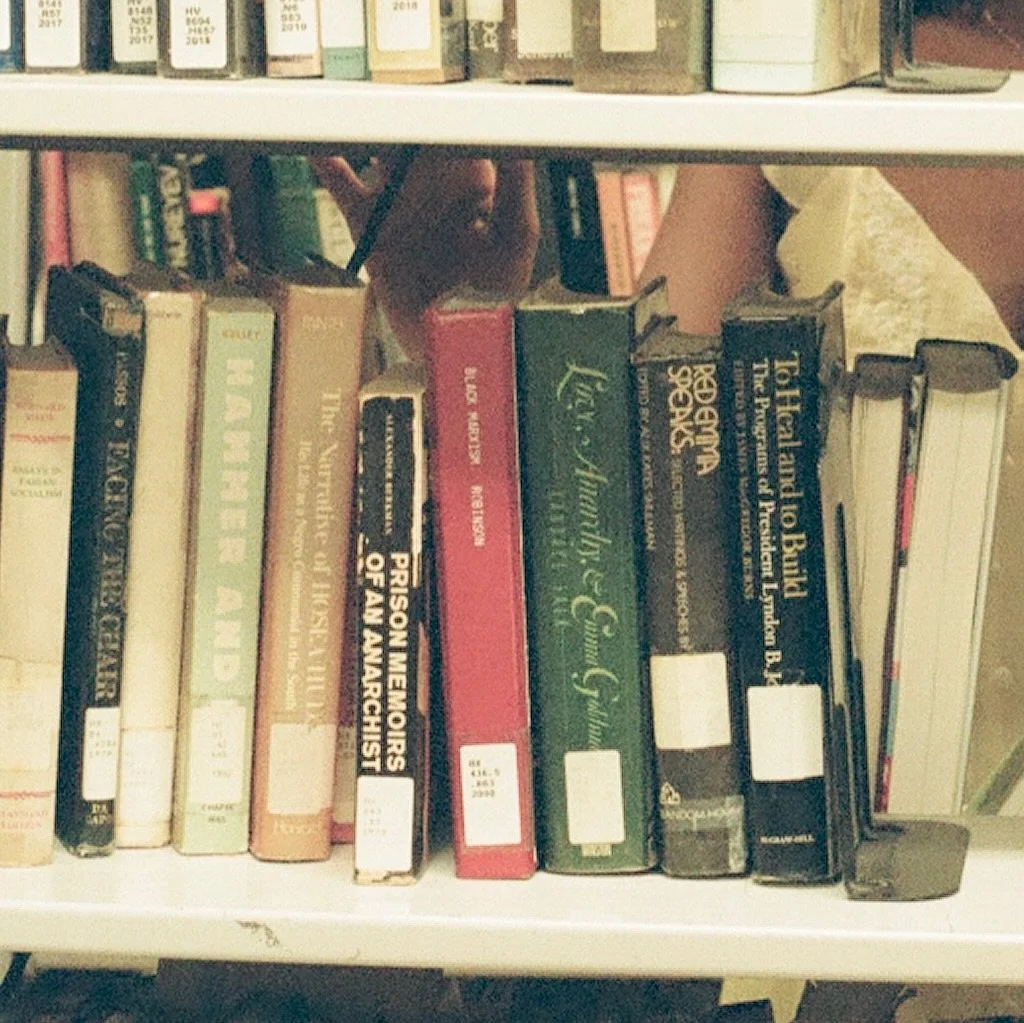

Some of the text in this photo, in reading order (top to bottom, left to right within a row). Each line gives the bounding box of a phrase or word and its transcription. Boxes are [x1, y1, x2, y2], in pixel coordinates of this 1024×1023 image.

[185, 6, 201, 16] HV
[320, 387, 342, 434] The
[691, 362, 718, 404] RED
[217, 358, 255, 564] HAMMER
[464, 367, 486, 548] BLACK MARXISM ROBINSON
[752, 358, 781, 647] The Programs of President Lyndon
[774, 350, 808, 600] To Heal and to Build
[363, 590, 384, 625] AN
[365, 552, 386, 588] OF
[95, 613, 123, 702] CHAIR
[212, 585, 244, 682] AND
[386, 552, 410, 773] PRISON MEMOIRS
[361, 629, 384, 773] ANARCHIST
